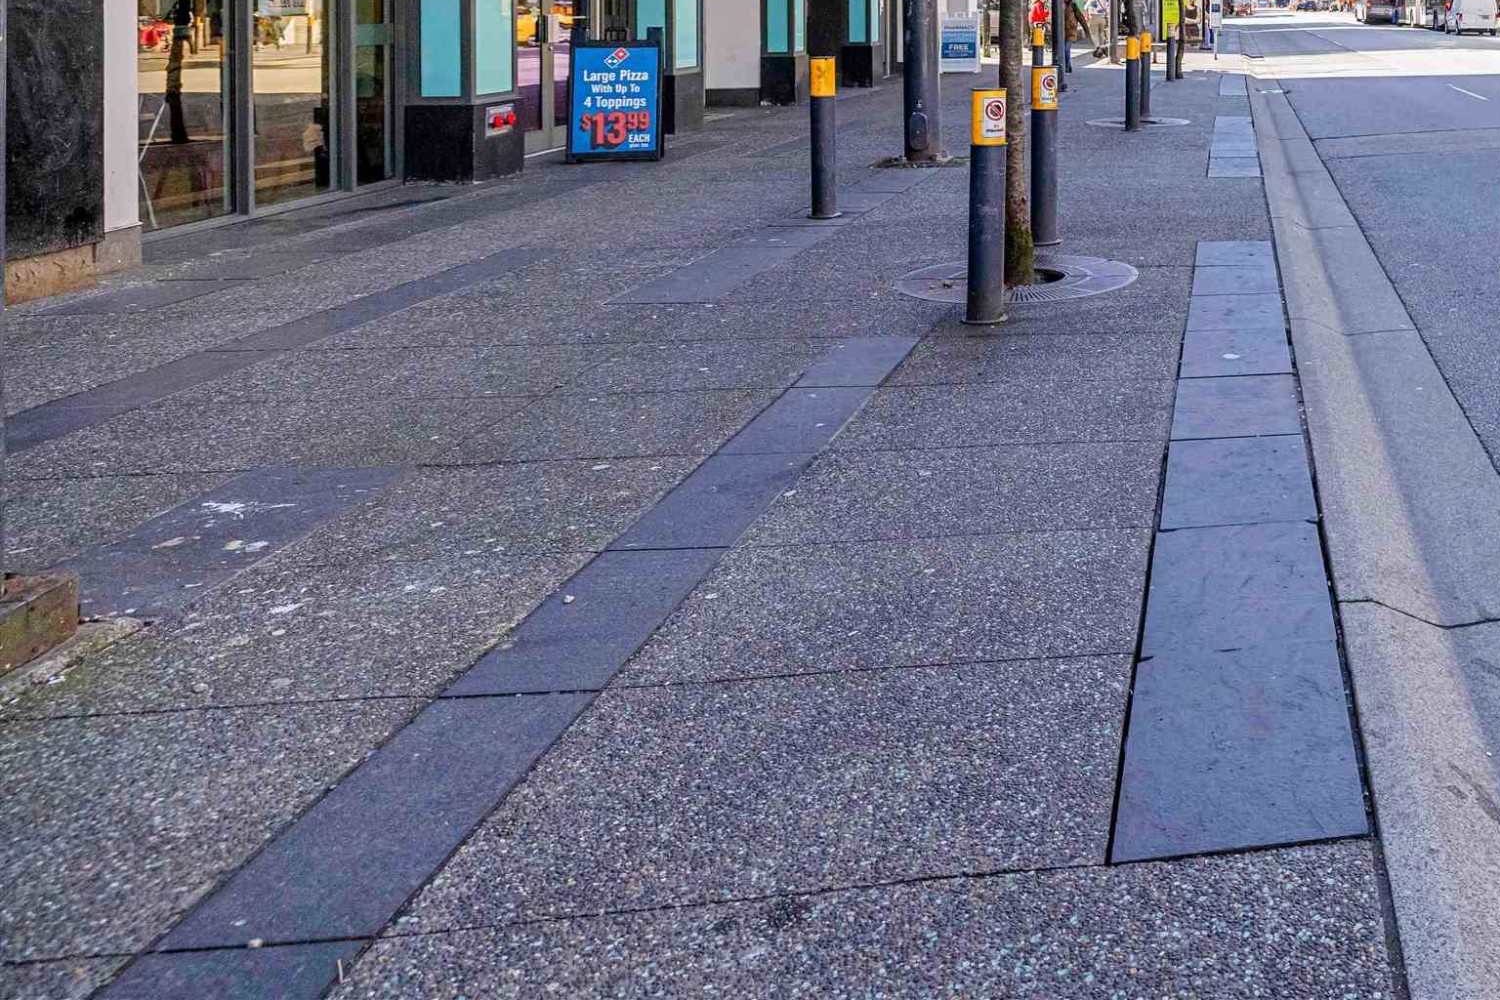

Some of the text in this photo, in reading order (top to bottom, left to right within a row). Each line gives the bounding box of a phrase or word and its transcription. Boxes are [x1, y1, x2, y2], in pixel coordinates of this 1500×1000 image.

[583, 69, 649, 83] Large Pizza
[591, 83, 640, 94] With Up To
[583, 95, 647, 109] 4 Toppings
[628, 133, 650, 143] EACH
